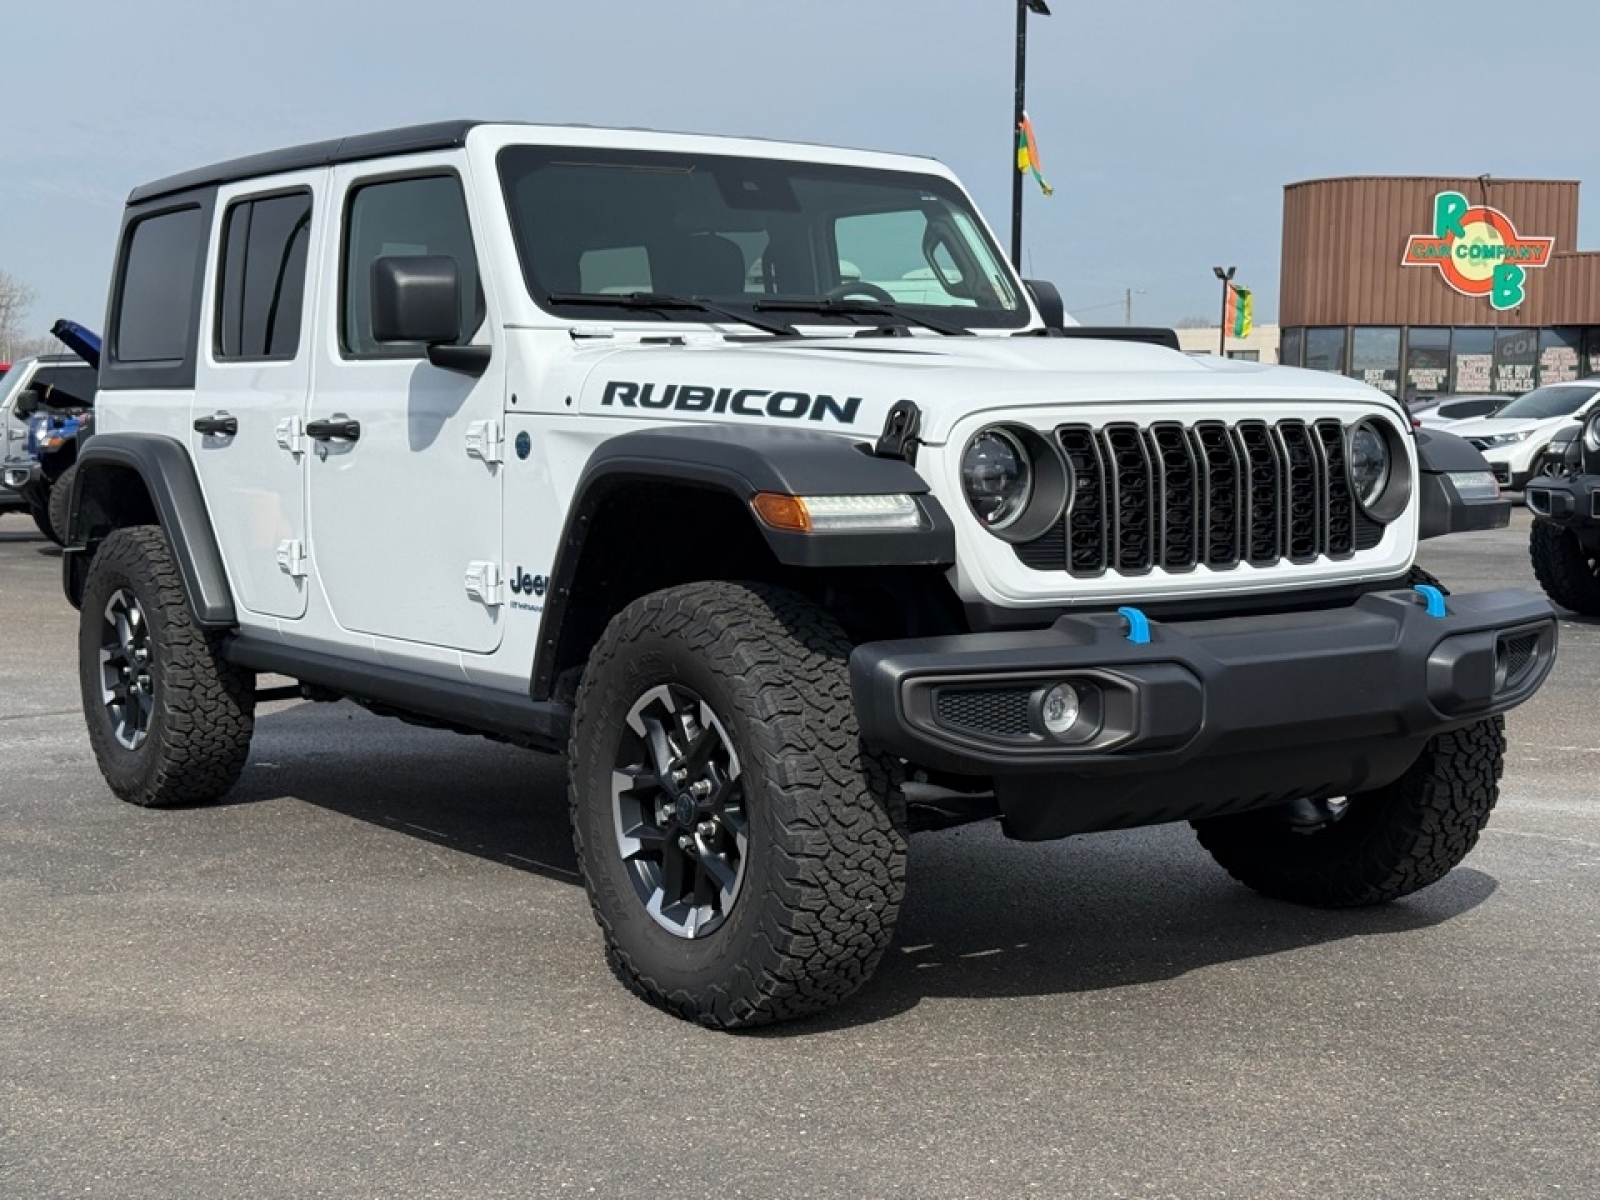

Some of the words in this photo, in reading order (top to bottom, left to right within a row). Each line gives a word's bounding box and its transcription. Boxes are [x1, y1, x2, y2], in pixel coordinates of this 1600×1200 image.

[1436, 193, 1466, 238] R
[1412, 242, 1451, 258] CAR
[1455, 244, 1546, 259] COMPANY
[1492, 264, 1525, 308] B
[1495, 378, 1535, 392] VEHICLES
[1497, 364, 1514, 379] WE
[1515, 364, 1534, 379] BUY
[601, 380, 863, 424] RUBICON
